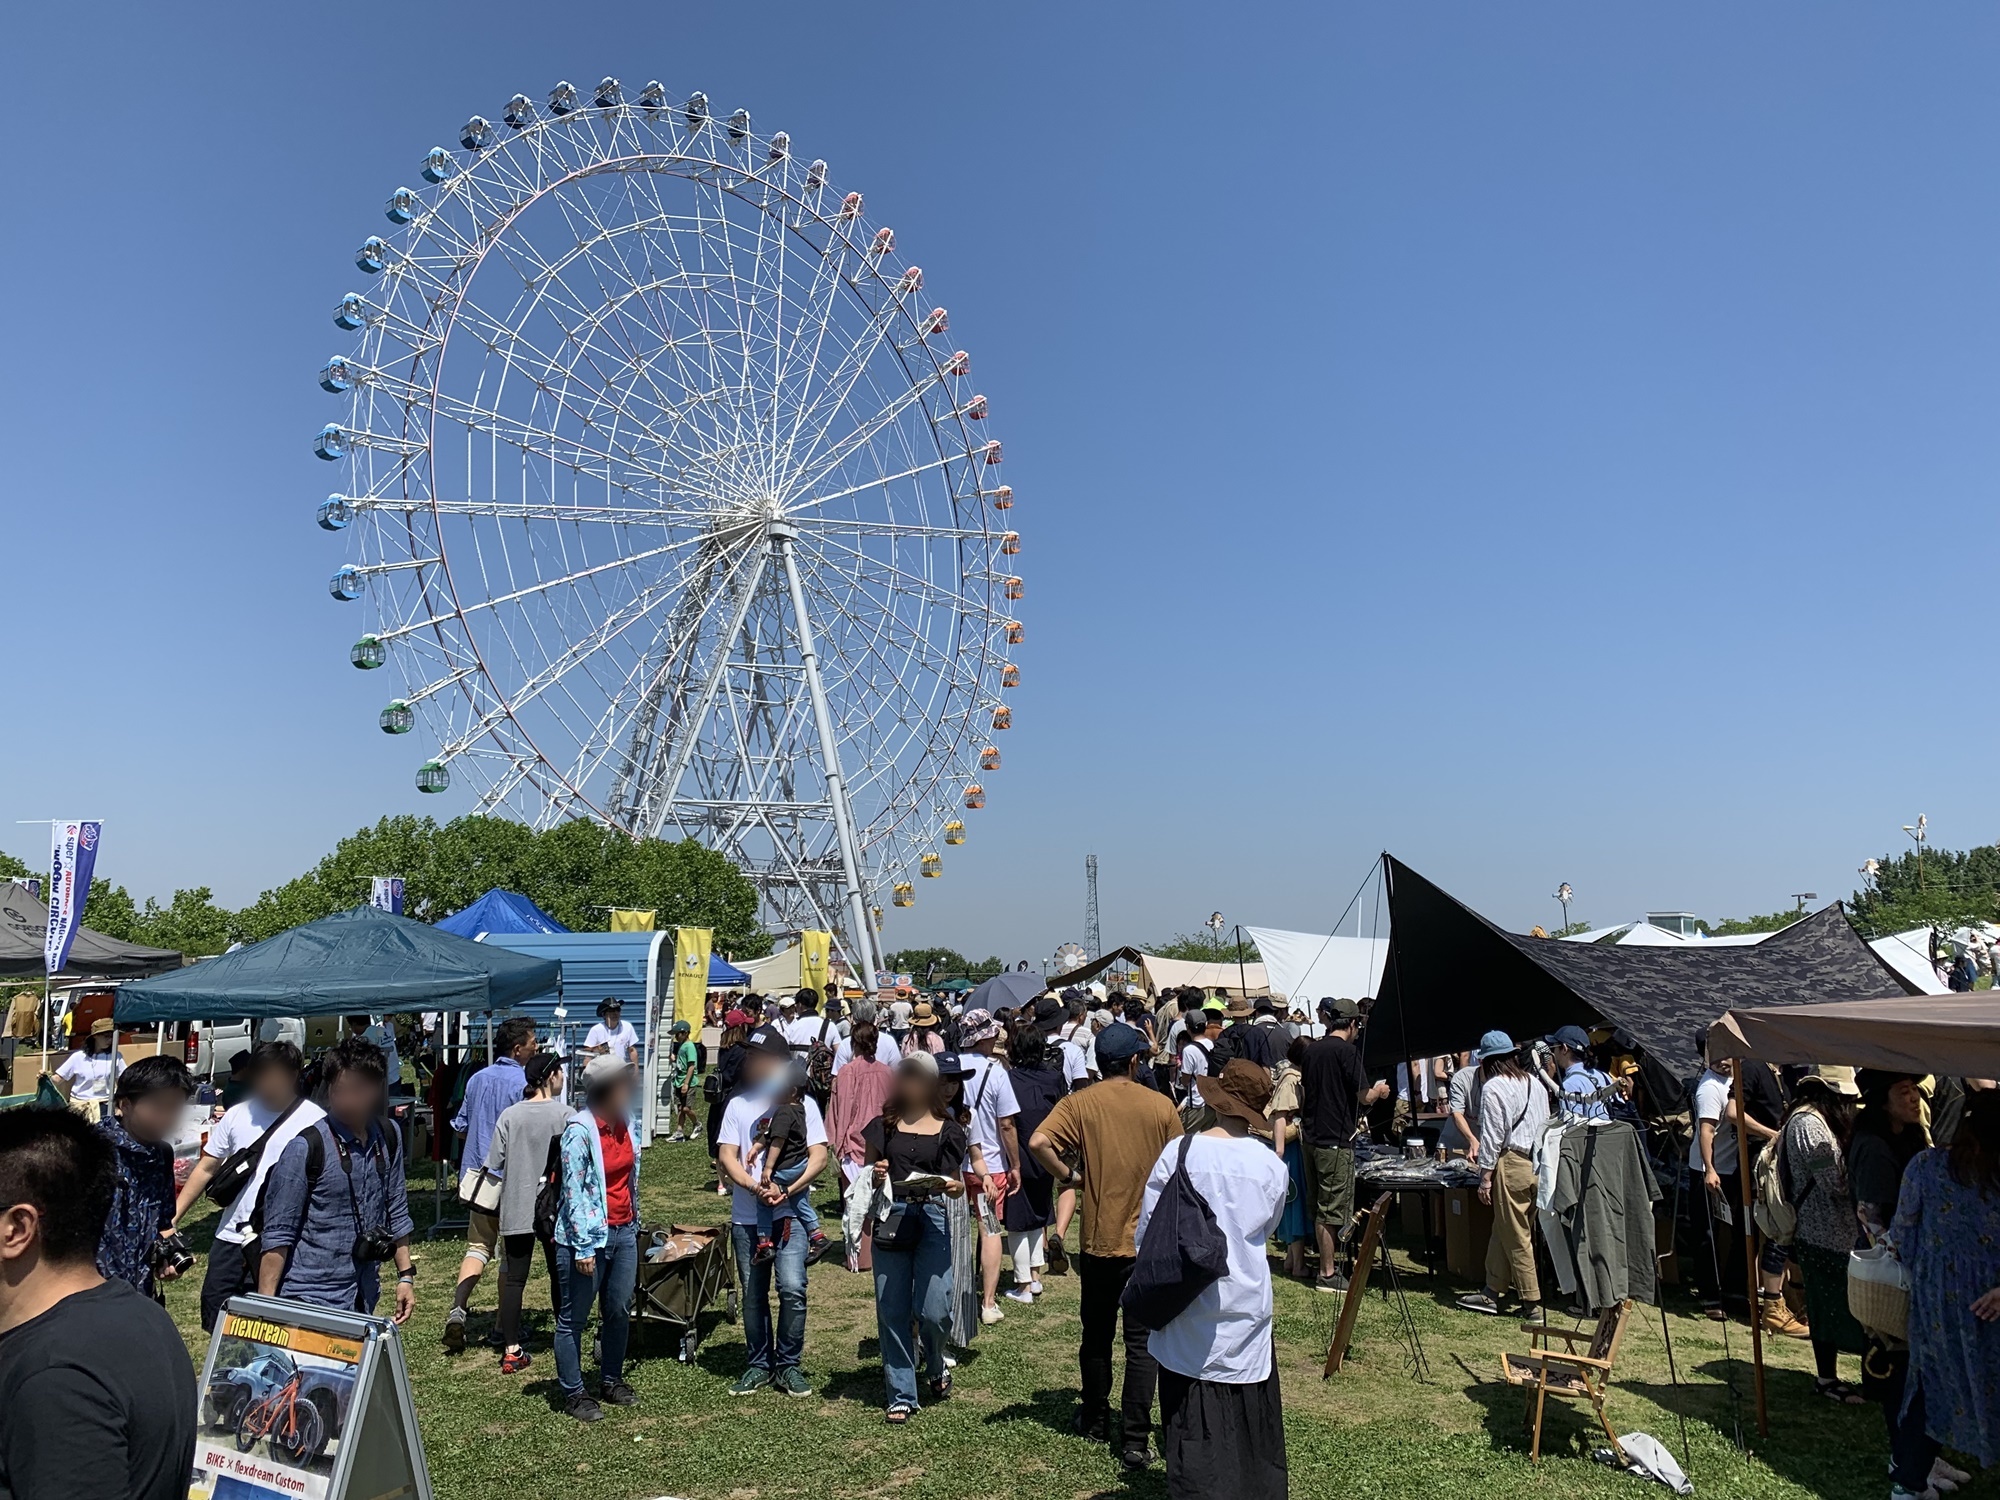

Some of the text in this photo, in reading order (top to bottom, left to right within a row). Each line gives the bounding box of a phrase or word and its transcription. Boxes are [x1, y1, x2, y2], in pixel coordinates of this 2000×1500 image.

[229, 1317, 290, 1347] flexdream
[206, 1452, 225, 1469] BIKE
[234, 1460, 274, 1483] flexdream
[275, 1472, 305, 1493] Custom
